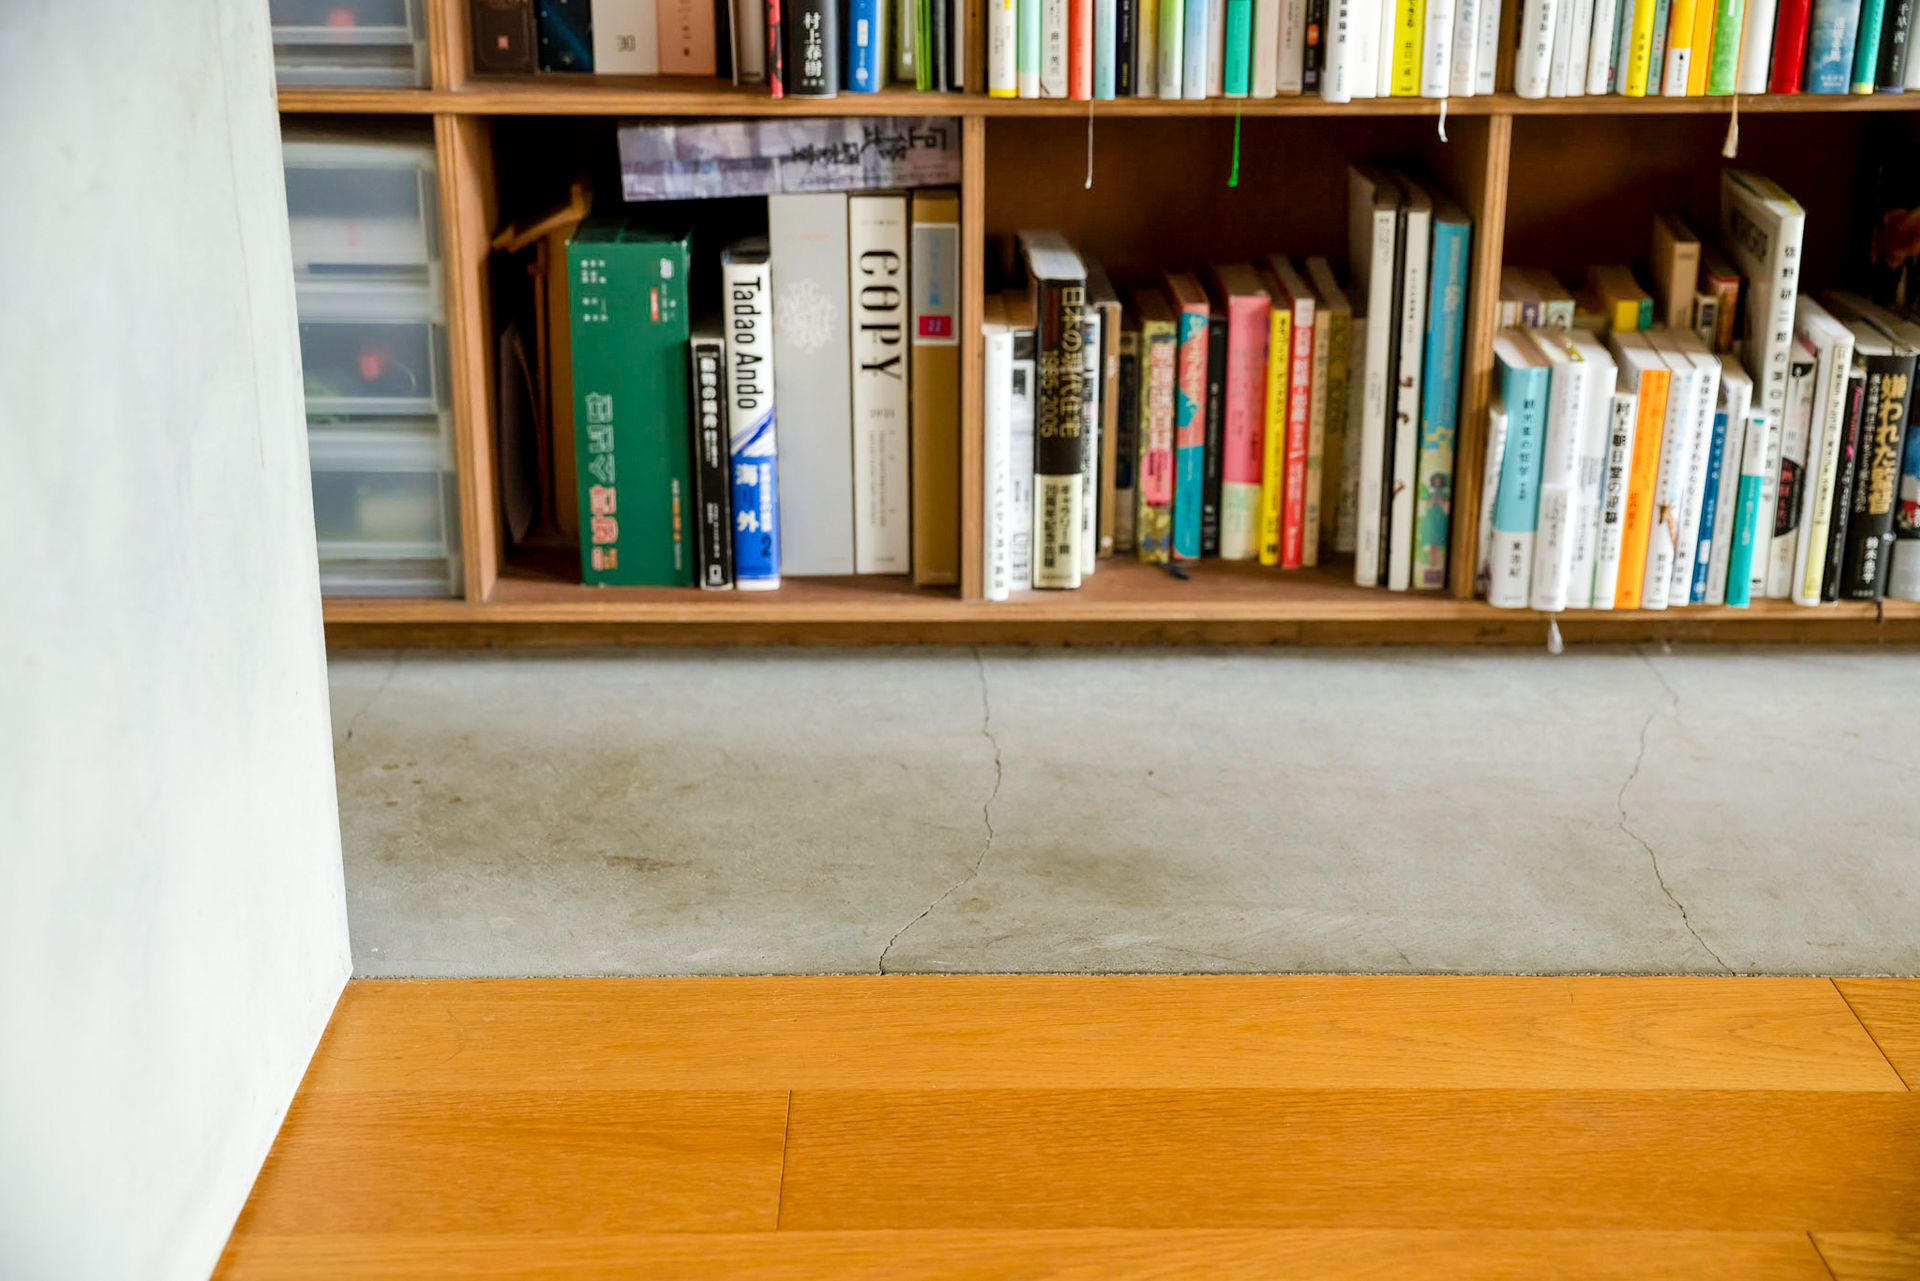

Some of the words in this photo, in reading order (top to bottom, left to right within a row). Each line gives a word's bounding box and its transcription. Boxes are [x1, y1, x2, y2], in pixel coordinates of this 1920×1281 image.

[803, 12, 822, 77] 村上春樹
[733, 276, 762, 345] Tadao
[860, 250, 902, 381] COPY
[736, 352, 764, 410] Ando
[1058, 286, 1085, 438] 日本の現代住宅
[1869, 372, 1908, 516] 嫌われた監督
[762, 535, 772, 557] 2
